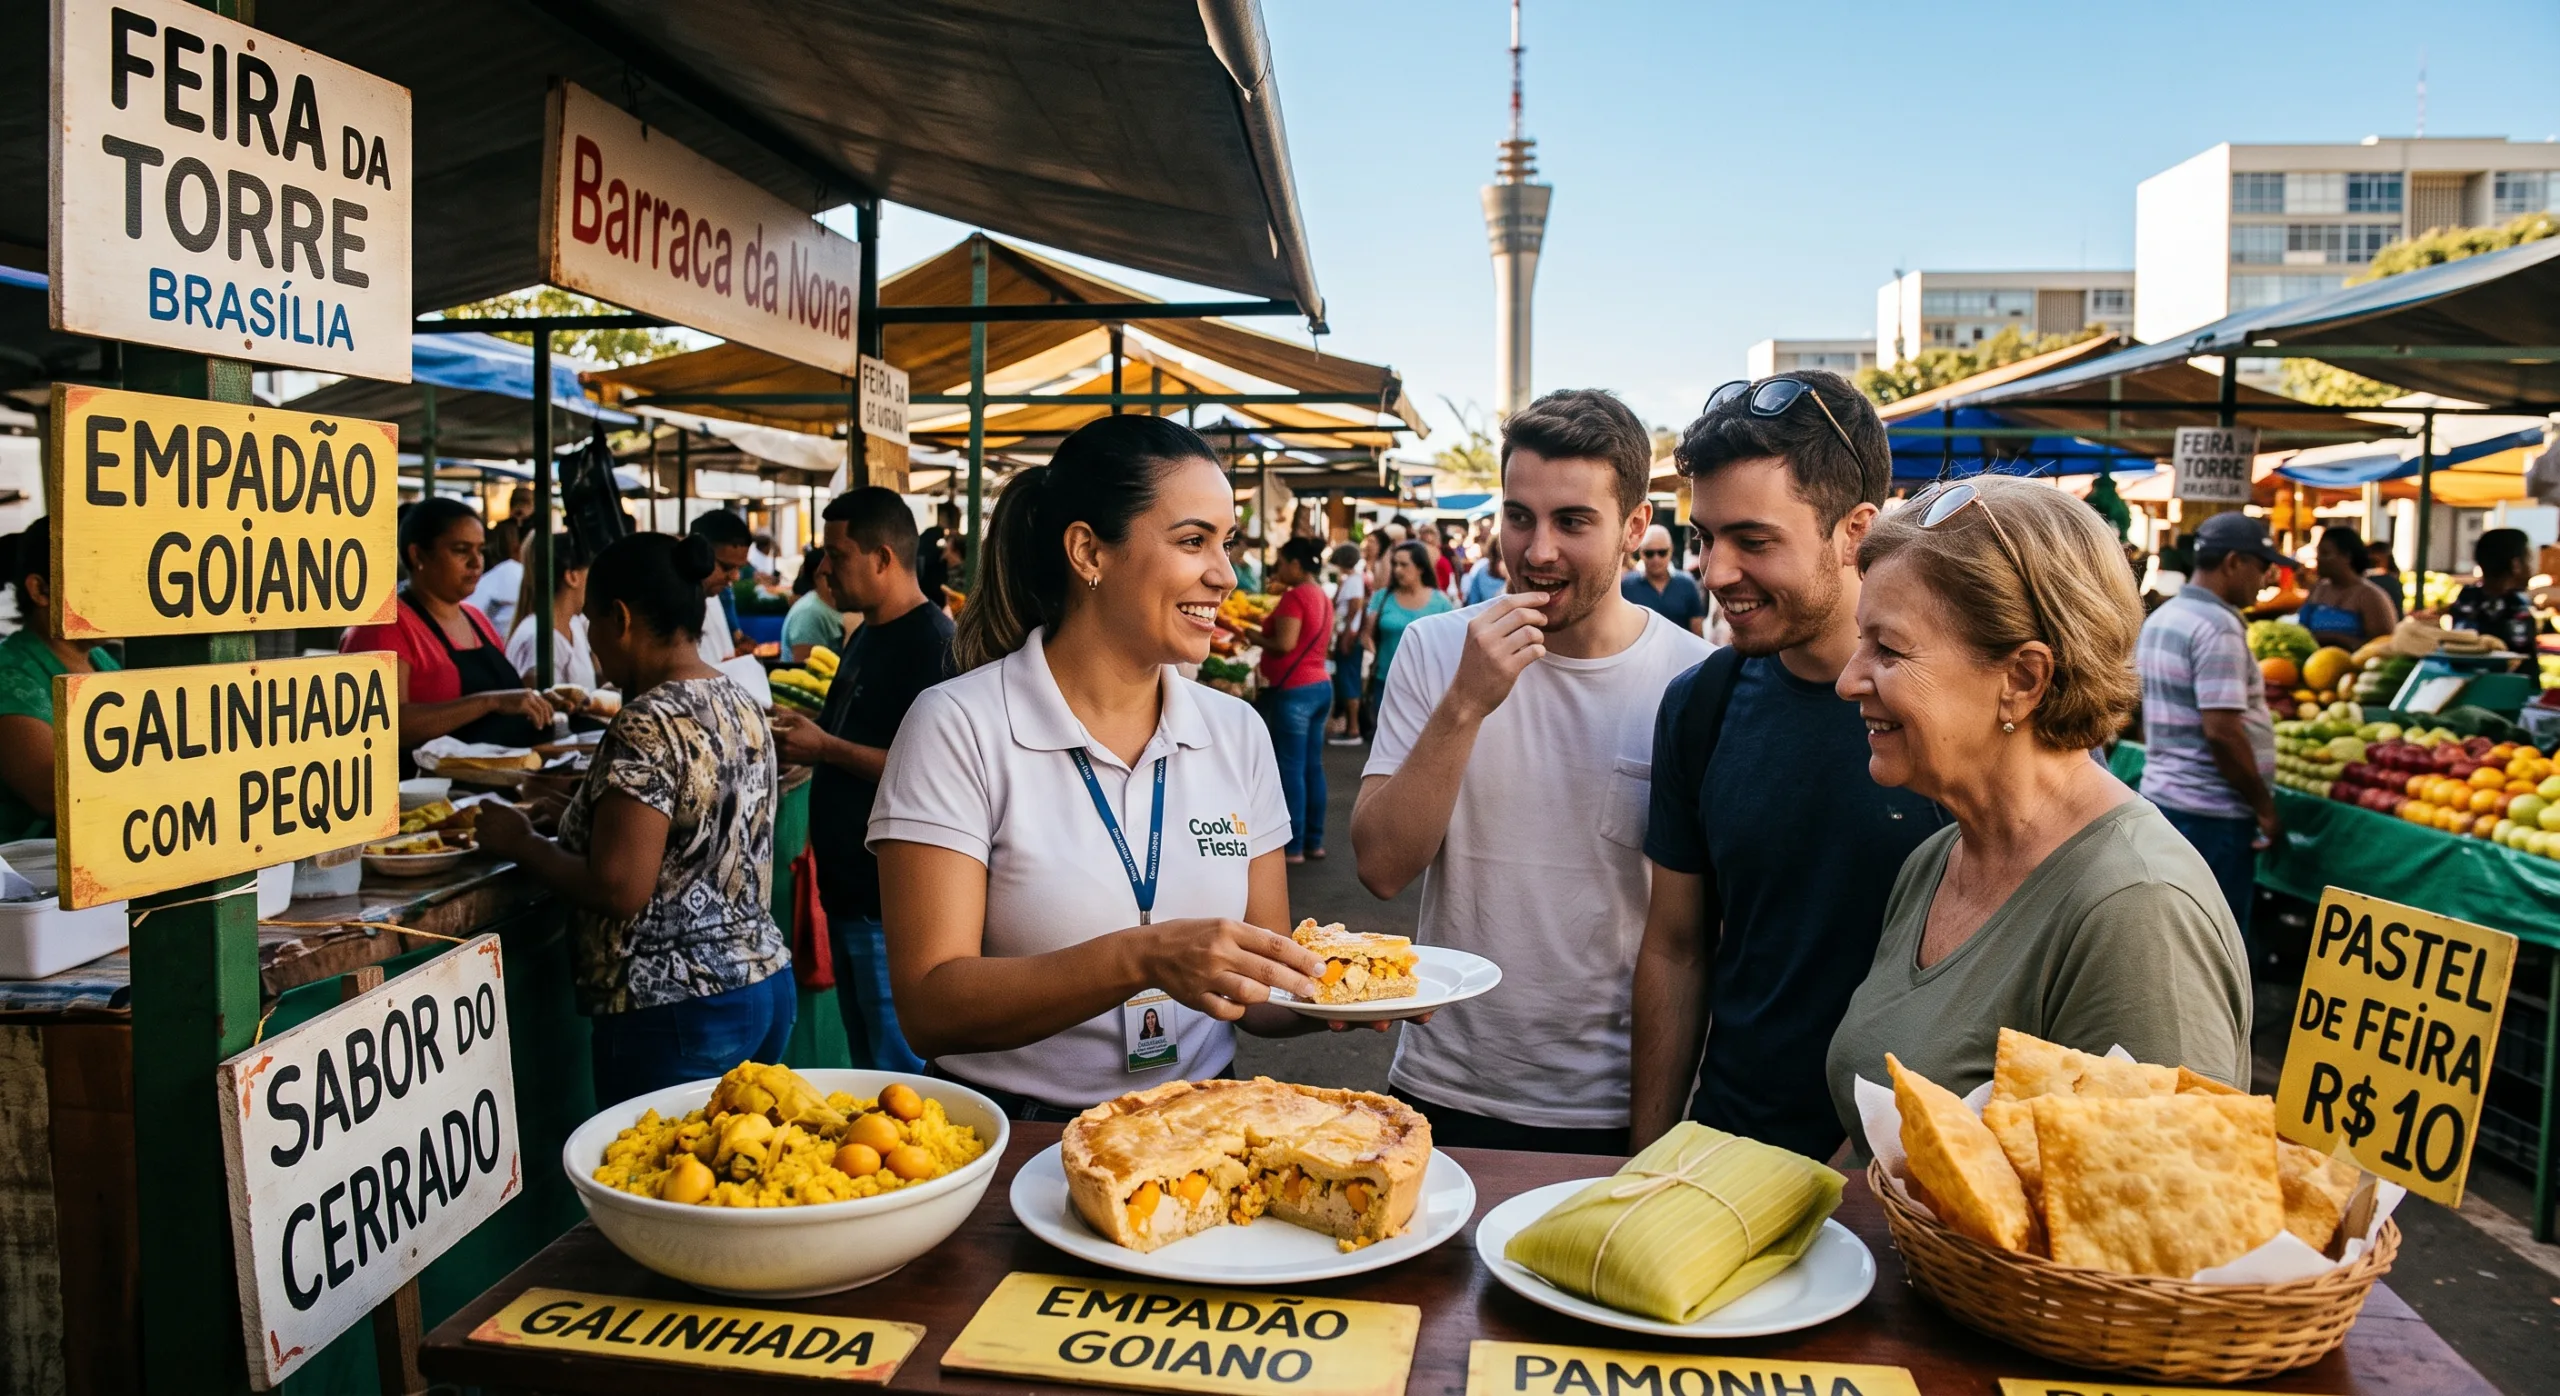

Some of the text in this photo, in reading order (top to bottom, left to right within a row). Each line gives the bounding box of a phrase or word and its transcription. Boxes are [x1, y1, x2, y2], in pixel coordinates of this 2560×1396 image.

[111, 6, 392, 191] FEIRA DA
[102, 134, 370, 289] TORRE
[572, 134, 851, 341] Barraca da Nona
[149, 266, 355, 352] BRASÍLIA
[86, 415, 376, 518] EMPADÃO
[2181, 432, 2235, 454] FEIRA
[2183, 457, 2245, 480] TORRE
[84, 669, 390, 773] GALINHADA
[122, 796, 217, 864] COM
[1196, 838, 1248, 857] Fiesta
[2317, 903, 2493, 1013] PASTEL
[2299, 988, 2347, 1042] DE
[266, 982, 496, 1168] SABOR DO
[2302, 1061, 2465, 1183] R$ 10
[281, 1087, 500, 1311] CERRADO
[520, 1301, 875, 1366] GALINHADA
[1037, 1285, 1349, 1341] EMPADÃO
[1059, 1330, 1313, 1383] GOIANO
